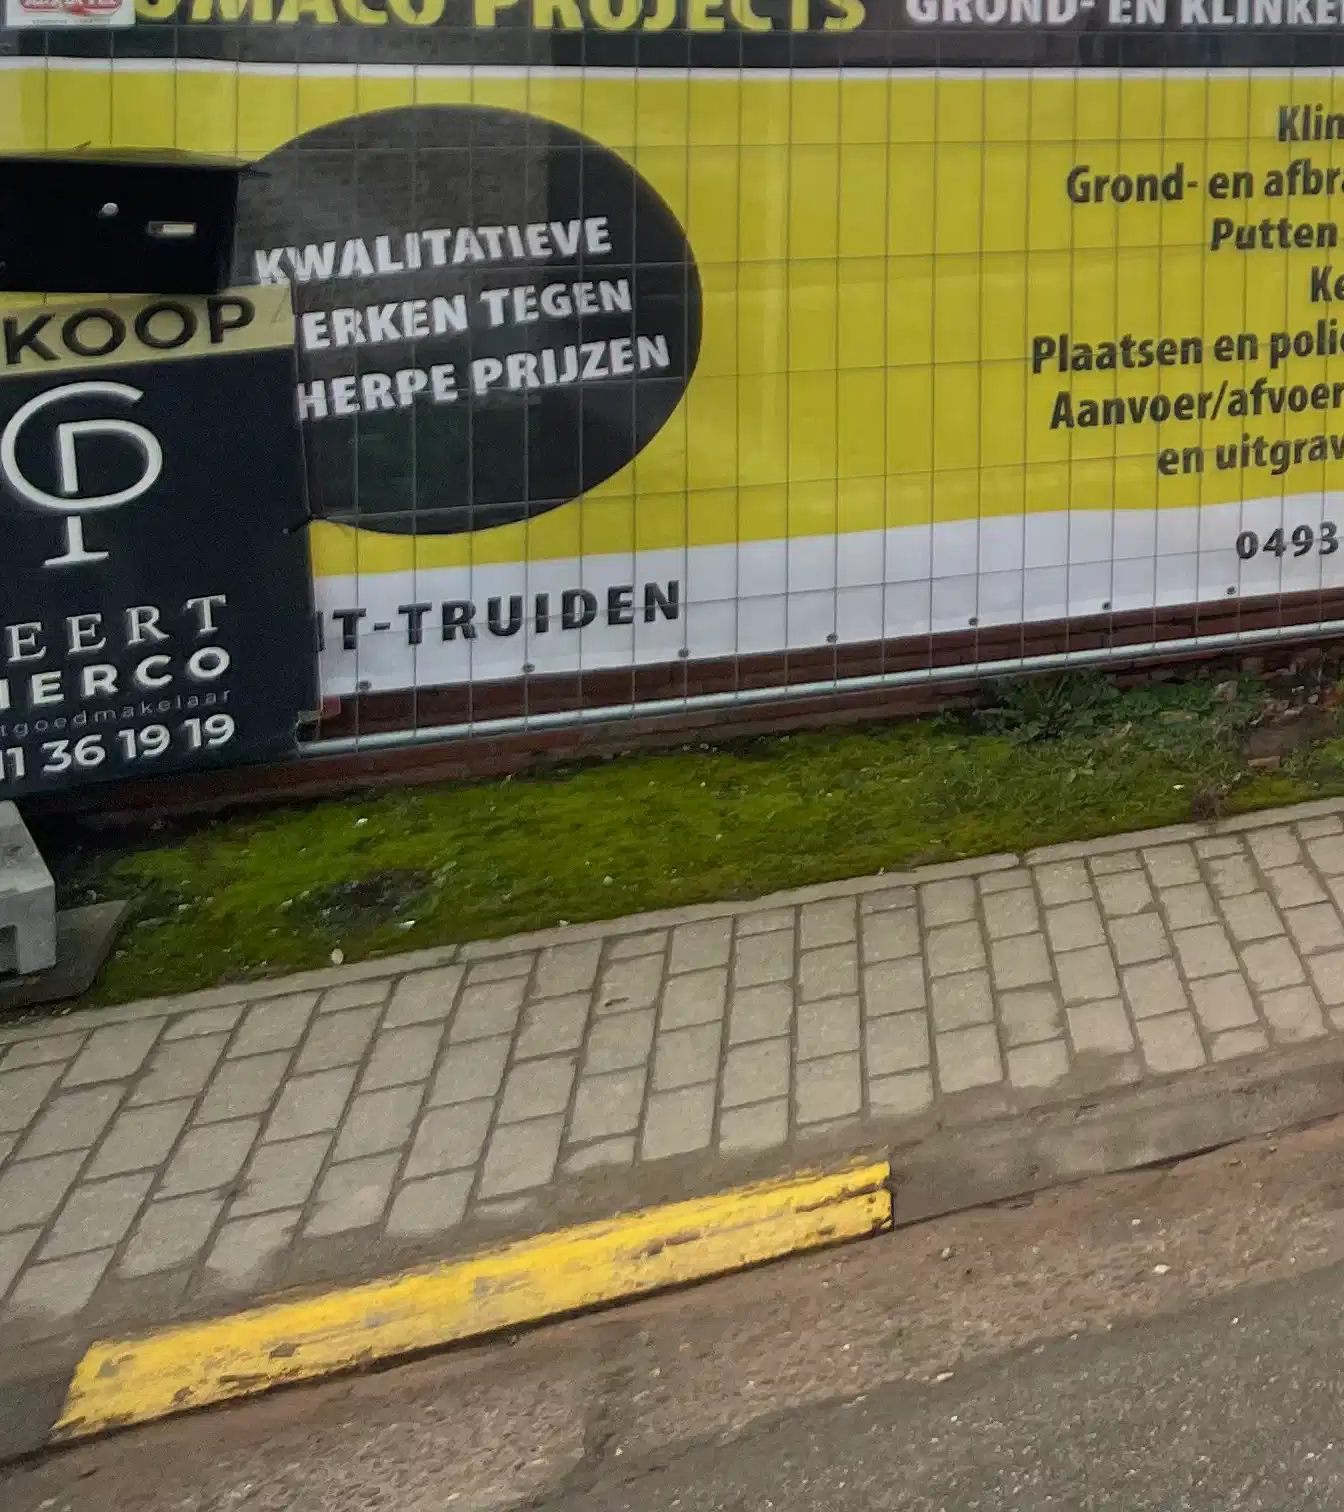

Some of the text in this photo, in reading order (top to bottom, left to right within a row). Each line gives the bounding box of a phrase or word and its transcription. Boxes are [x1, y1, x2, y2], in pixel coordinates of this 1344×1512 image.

[1066, 163, 1198, 203] Grond-
[1208, 170, 1253, 199] en
[254, 216, 613, 286] KWALITATIEVE
[1210, 216, 1337, 251] Putten
[480, 278, 633, 328] TEGEN
[2, 295, 256, 366] KOOP
[1032, 331, 1202, 374] Plaatsen
[1213, 333, 1258, 363] en
[472, 333, 671, 394] PRIJZEN
[1158, 447, 1205, 476] en
[1236, 521, 1338, 561] 0493
[42, 734, 106, 773] 36
[118, 723, 171, 760] 19
[184, 713, 236, 748] 19
